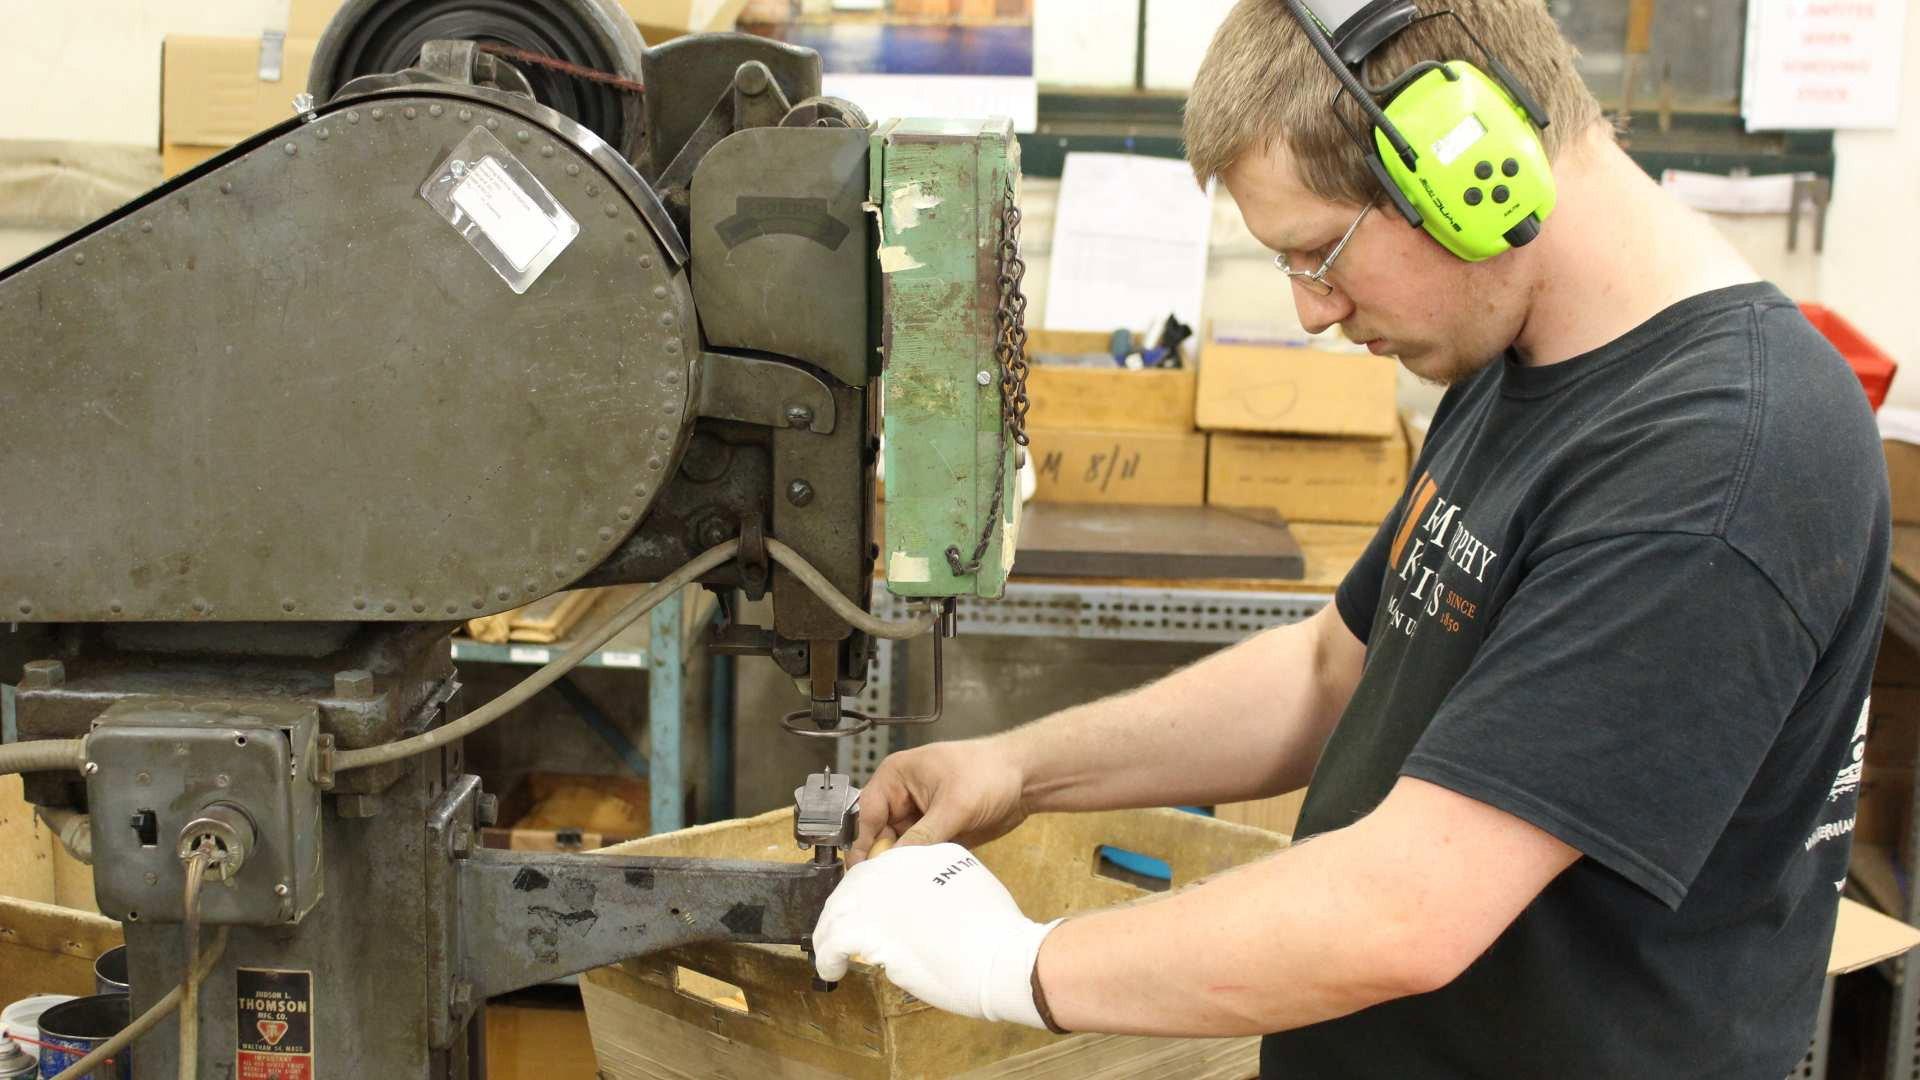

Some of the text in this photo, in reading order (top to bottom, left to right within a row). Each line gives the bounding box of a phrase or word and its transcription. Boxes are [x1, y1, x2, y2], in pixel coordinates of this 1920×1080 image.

[1446, 590, 1477, 620] SINCE
[1440, 611, 1461, 633] 1850
[932, 857, 979, 886] ULINE
[239, 998, 307, 1013] THOMSON
